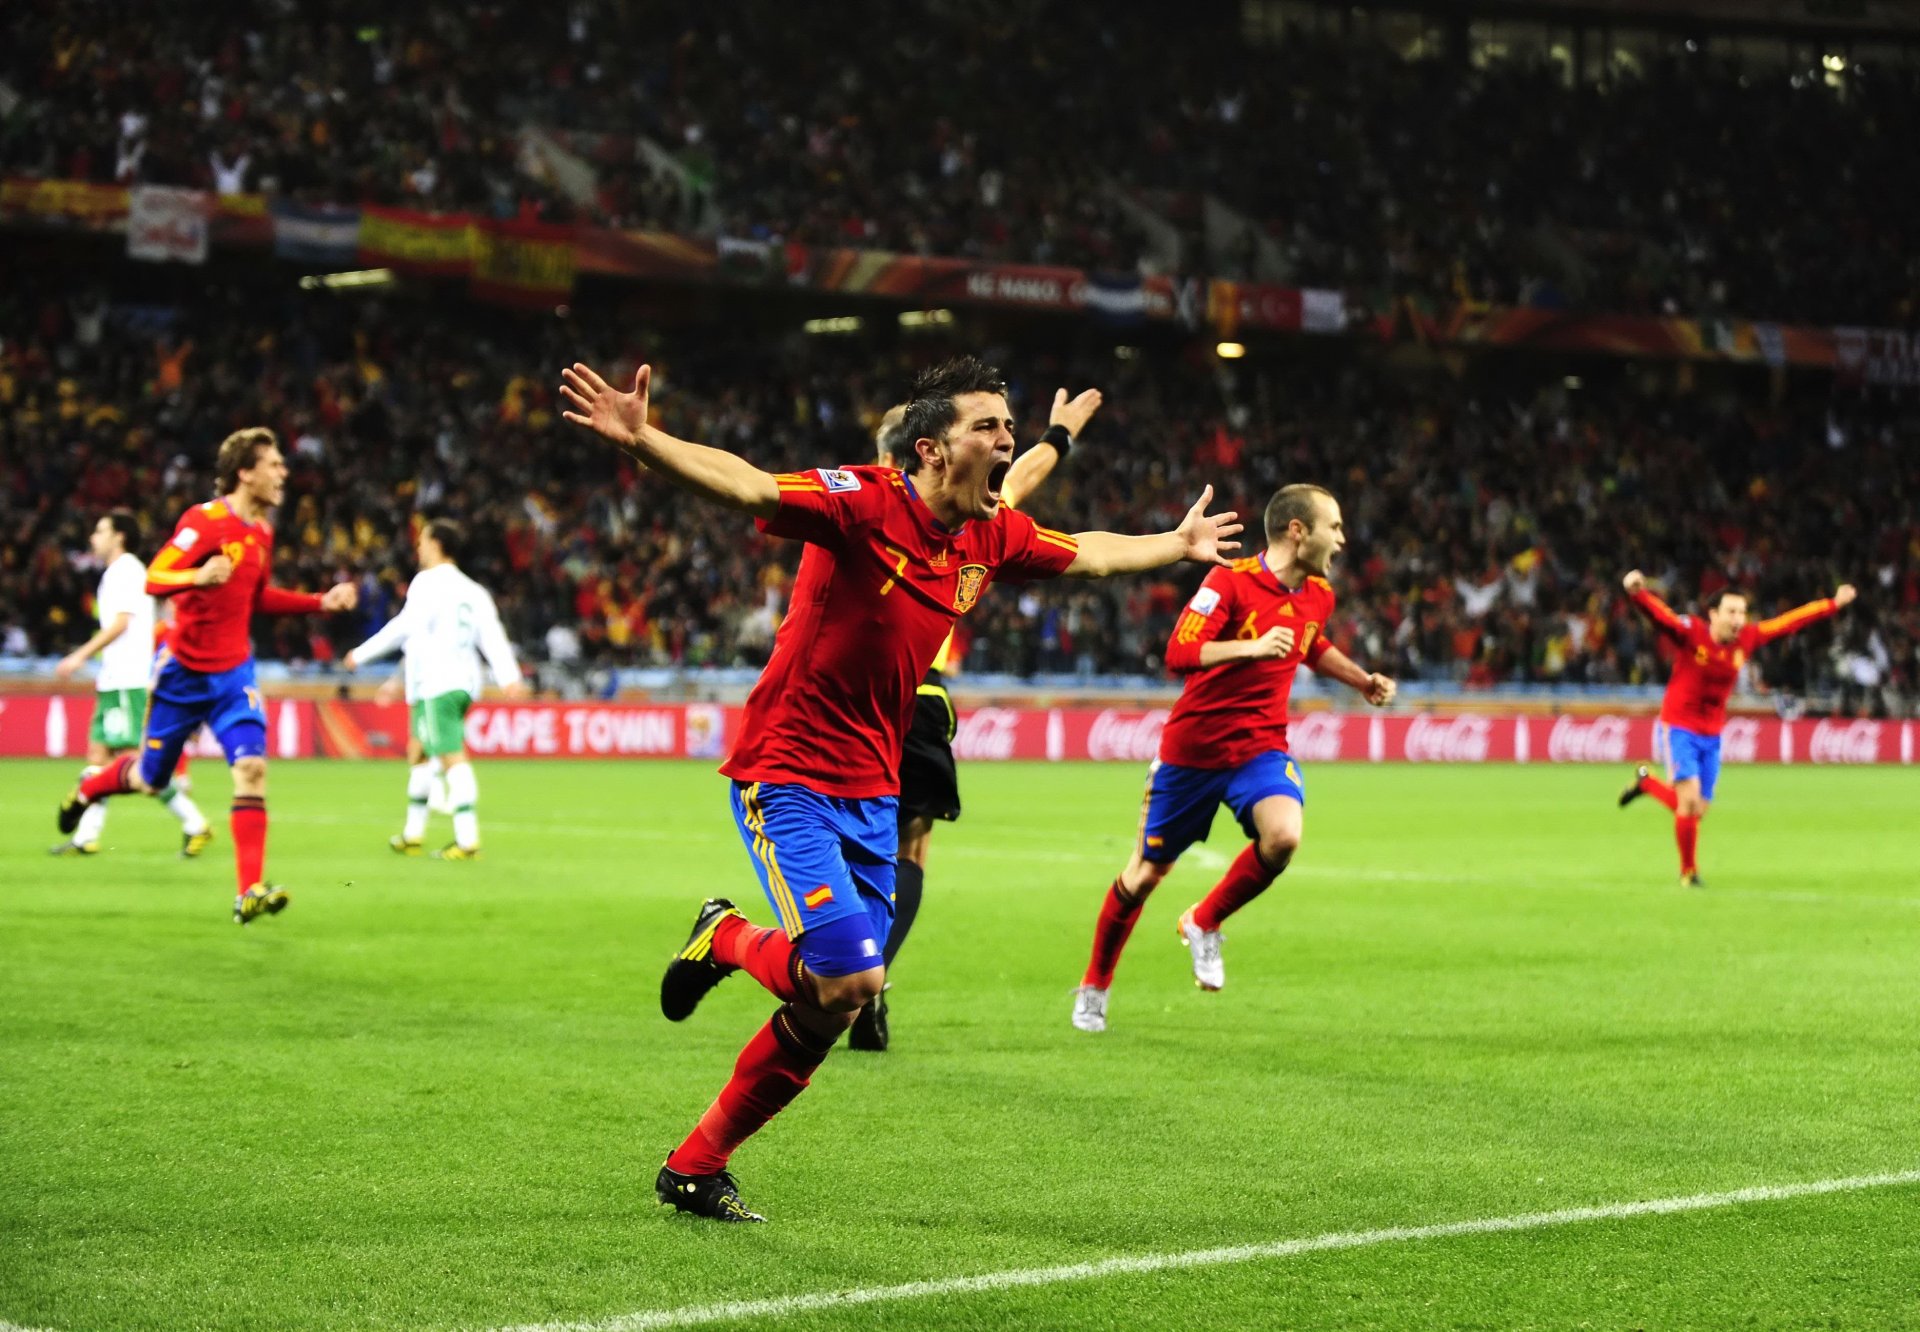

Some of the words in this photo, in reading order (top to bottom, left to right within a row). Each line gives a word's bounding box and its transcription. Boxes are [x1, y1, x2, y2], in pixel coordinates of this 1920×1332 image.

[880, 546, 909, 596] 7
[1236, 610, 1258, 641] 6
[464, 708, 559, 754] CAPE
[563, 708, 677, 754] TOWN
